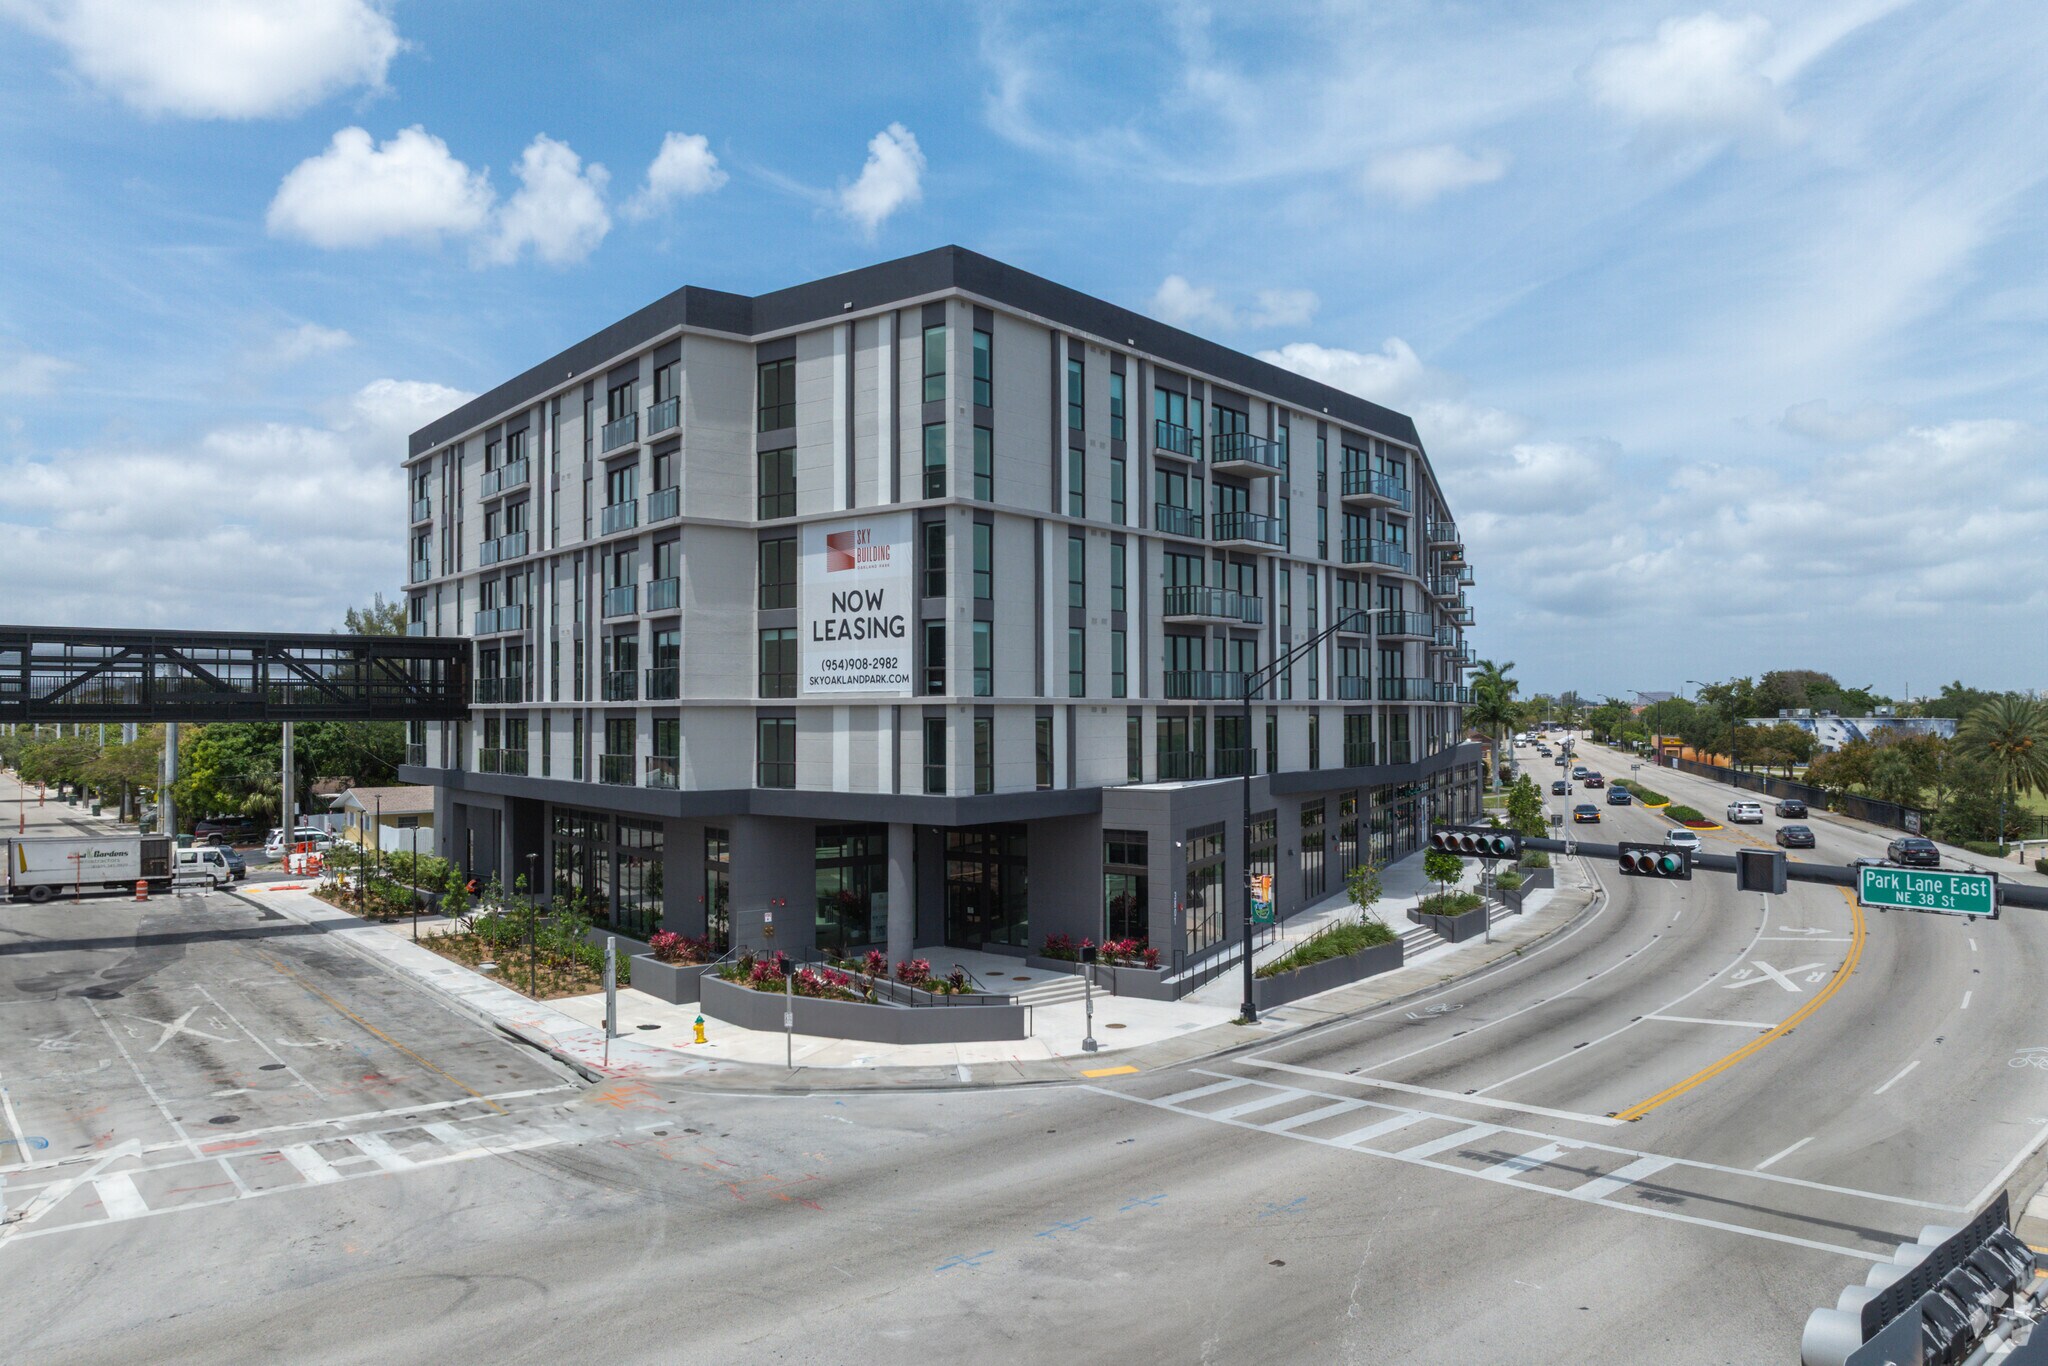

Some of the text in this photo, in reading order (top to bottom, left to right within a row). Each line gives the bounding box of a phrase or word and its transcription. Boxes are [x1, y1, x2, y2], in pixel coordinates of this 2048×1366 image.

[857, 528, 871, 545] SKY
[857, 545, 890, 563] BUILDING
[832, 588, 884, 613] NOW
[813, 615, 905, 642] LEASING
[821, 657, 898, 672] (954)908-2982
[809, 674, 910, 686] SKYOAKLANDPARK.COM
[1866, 871, 1987, 897] Park Lane East
[1896, 891, 1955, 907] NE 38 St
